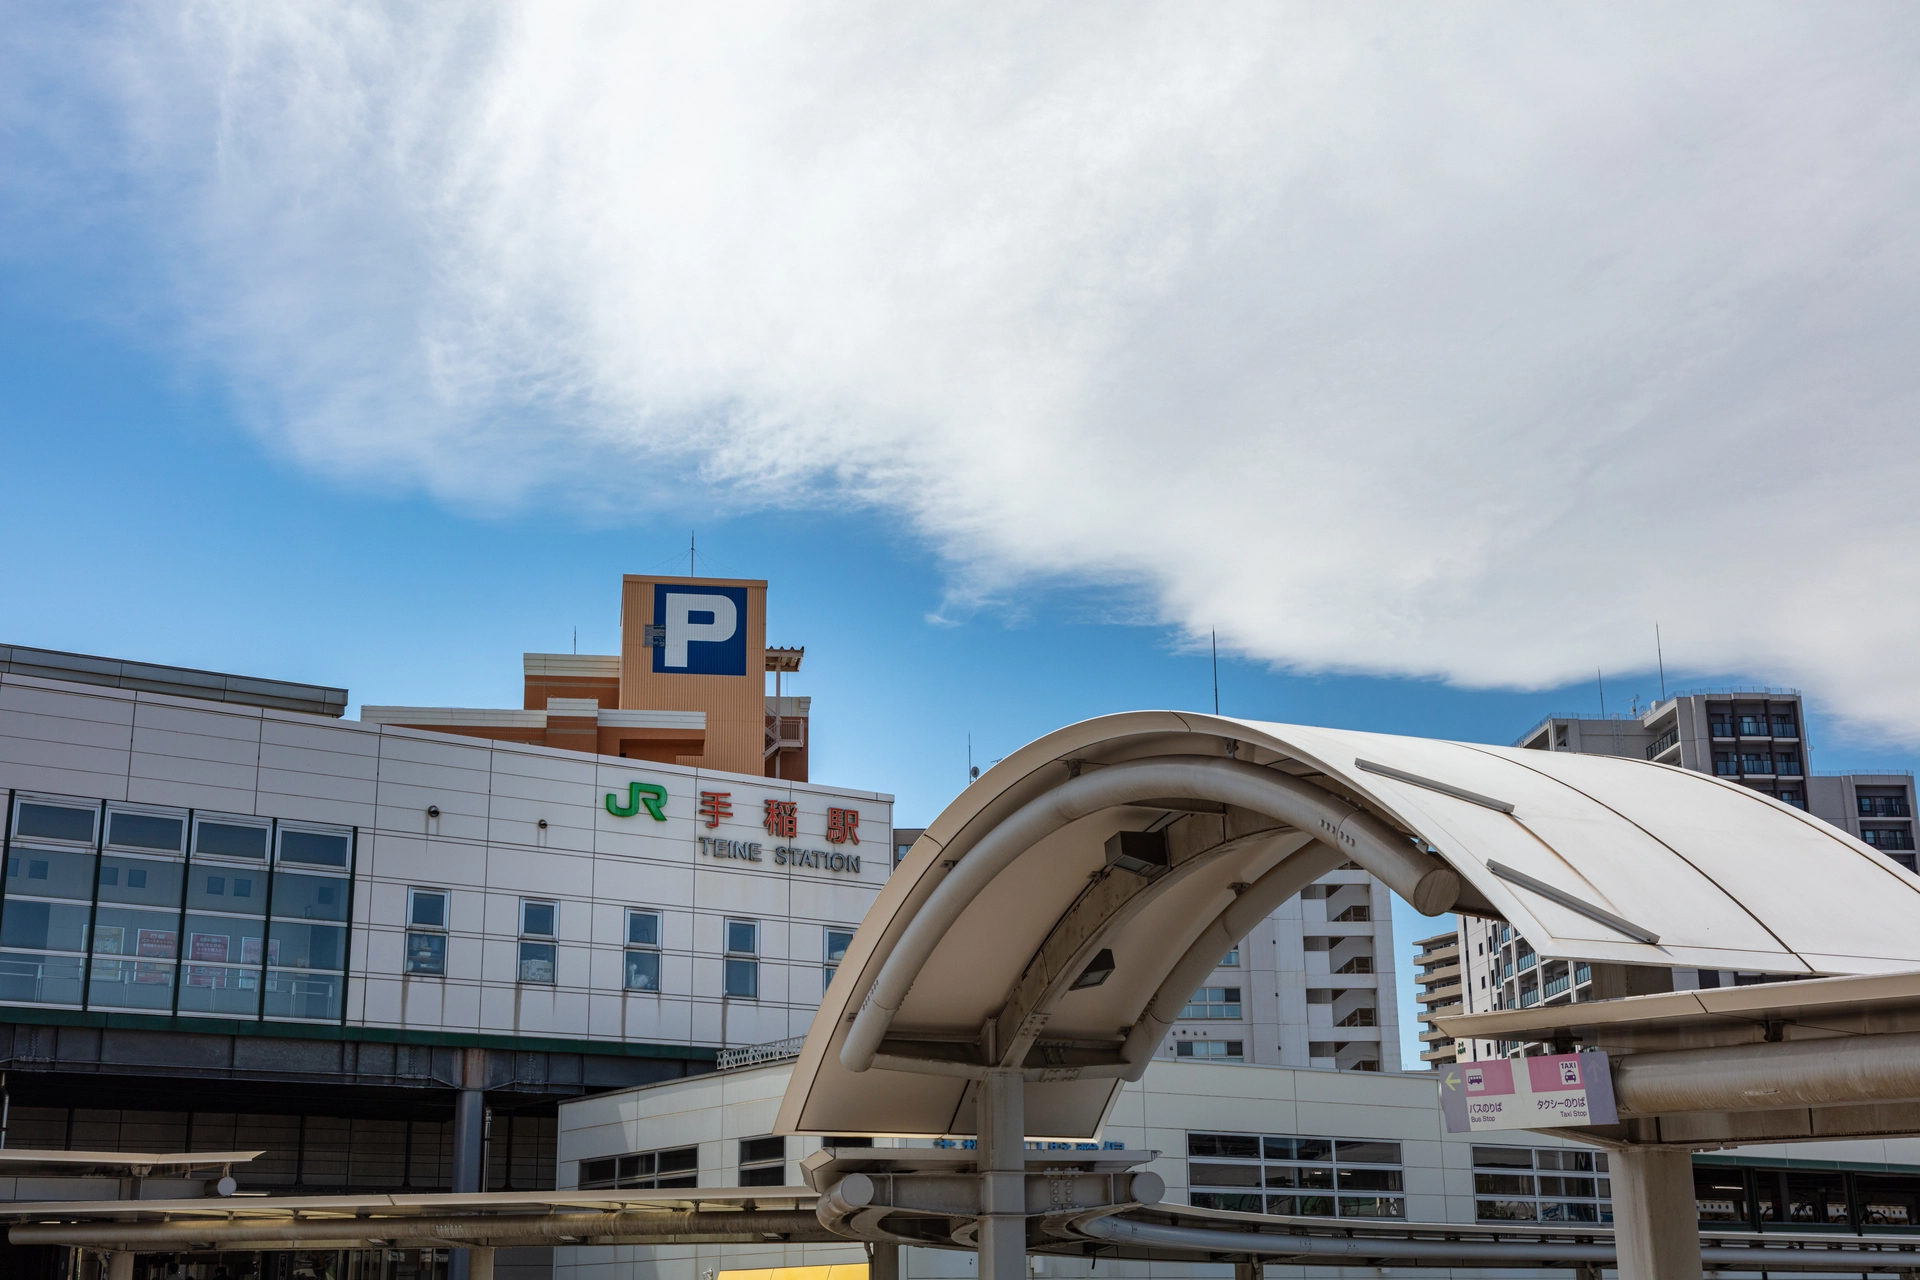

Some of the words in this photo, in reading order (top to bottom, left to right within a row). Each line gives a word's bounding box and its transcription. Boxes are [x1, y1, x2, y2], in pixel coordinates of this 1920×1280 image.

[664, 592, 738, 668] P
[606, 781, 668, 822] JR
[698, 790, 860, 844] 手稲駅
[698, 836, 763, 863] TEINE
[774, 845, 861, 874] STATION
[1560, 1061, 1577, 1070] TAXI
[1469, 1101, 1503, 1114] バスのりば
[1537, 1097, 1586, 1110] タクシーのりば
[1482, 1115, 1496, 1123] Stop
[1560, 1110, 1573, 1118] Taxi
[1573, 1110, 1587, 1118] Stop
